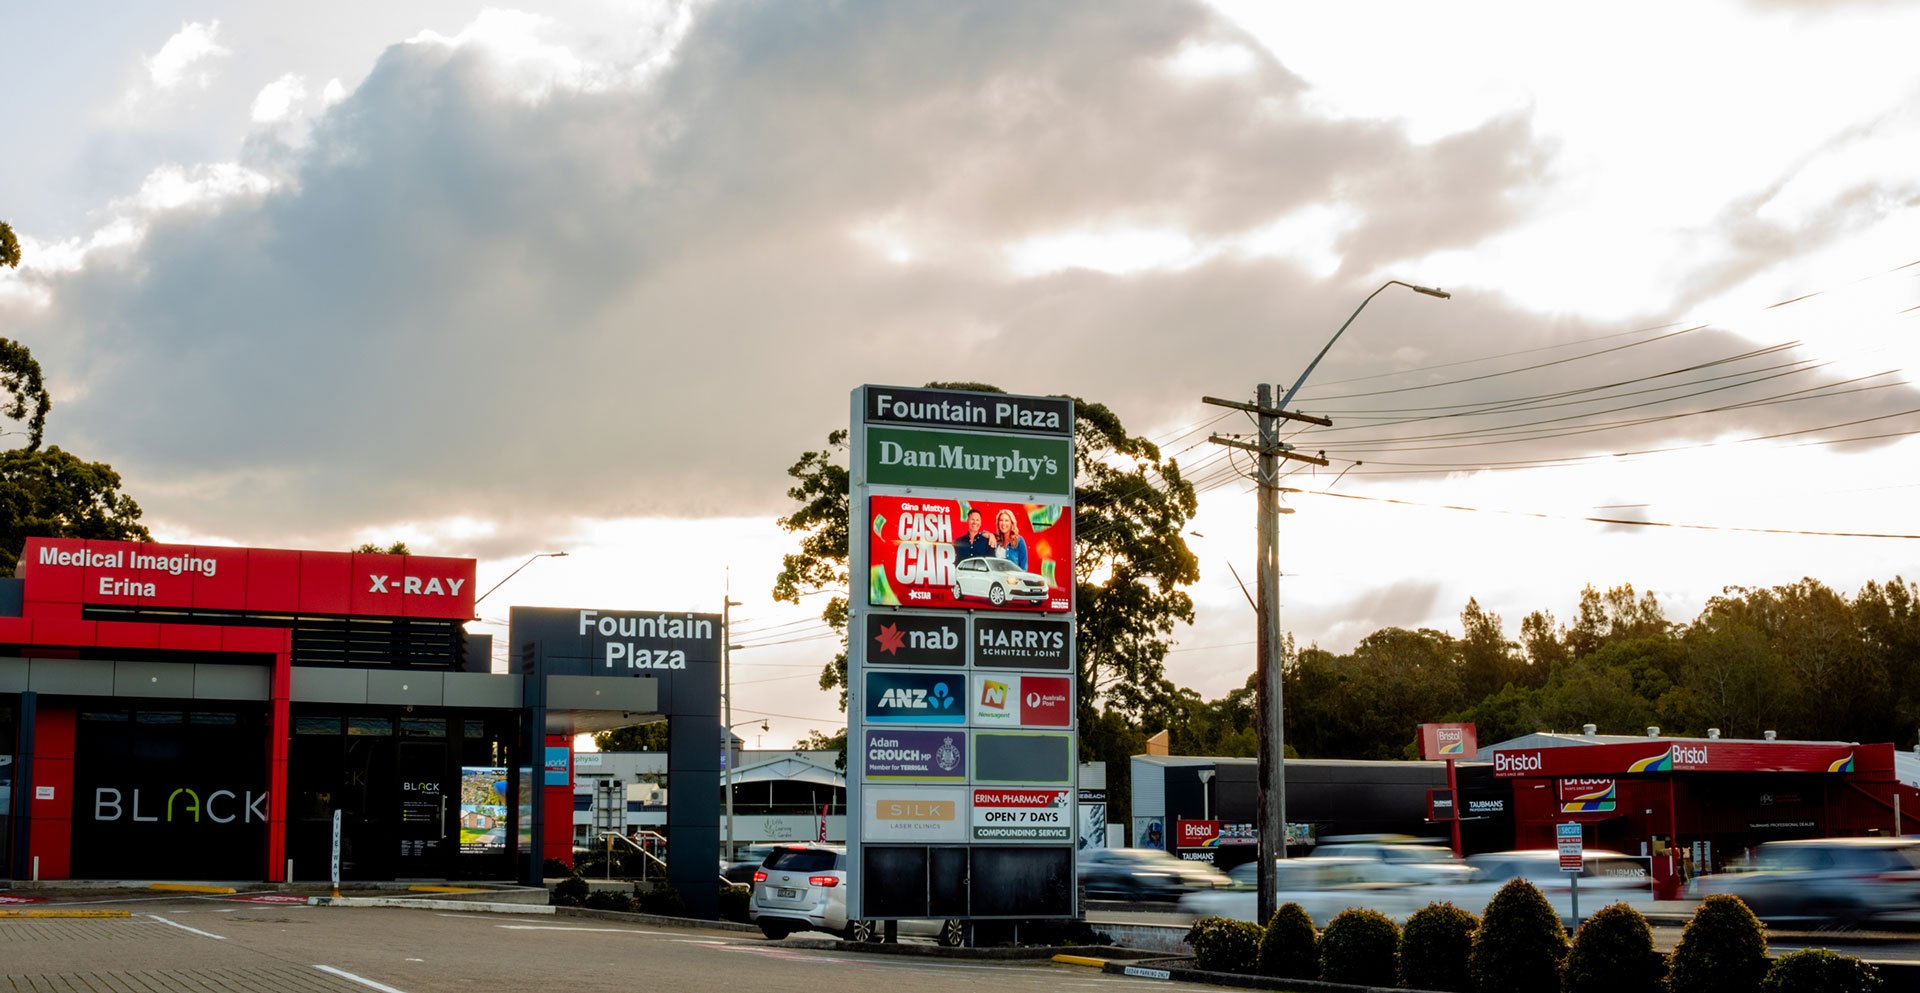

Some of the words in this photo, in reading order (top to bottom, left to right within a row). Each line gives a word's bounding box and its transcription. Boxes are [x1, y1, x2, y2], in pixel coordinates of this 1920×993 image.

[877, 395, 986, 423] Fountain
[995, 403, 1060, 428] Plaza
[879, 441, 936, 468] Dan
[938, 445, 1058, 480] Murphy's
[901, 502, 919, 511] Gina
[898, 512, 952, 543] CASH
[39, 546, 123, 569] Medical
[130, 551, 217, 577] Imaging
[896, 541, 957, 586] CAR
[99, 577, 156, 597] Erina
[369, 575, 465, 596] X-RAY
[578, 610, 713, 640] Fountain
[909, 626, 958, 650] nab
[980, 629, 1064, 649] HARRYS
[606, 641, 686, 670] Plaza
[982, 648, 1032, 657] SCHNITZEL
[1034, 650, 1061, 658] JOINT
[877, 688, 928, 708] ANZ
[870, 738, 899, 748] Adam
[1439, 731, 1460, 740] Bristol
[869, 749, 920, 761] CROUCH
[1495, 752, 1542, 771] Bristol
[1672, 744, 1708, 764] Bristol
[403, 782, 440, 791] BLACK
[95, 787, 270, 823] BLACK
[975, 794, 1001, 803] ERINA
[1002, 795, 1049, 804] PHARMACY
[1469, 800, 1504, 808] TAUBMANS
[890, 804, 942, 817] SILK
[985, 812, 1016, 822] OPEN
[1020, 812, 1027, 821] 7
[1030, 813, 1059, 822] DAYS
[977, 828, 1037, 837] COMPOUNDING
[1038, 829, 1067, 837] SERVICE
[1185, 824, 1212, 836] Bristol
[1182, 852, 1215, 860] TAUBMANS
[1605, 868, 1646, 877] TAUBMANS
